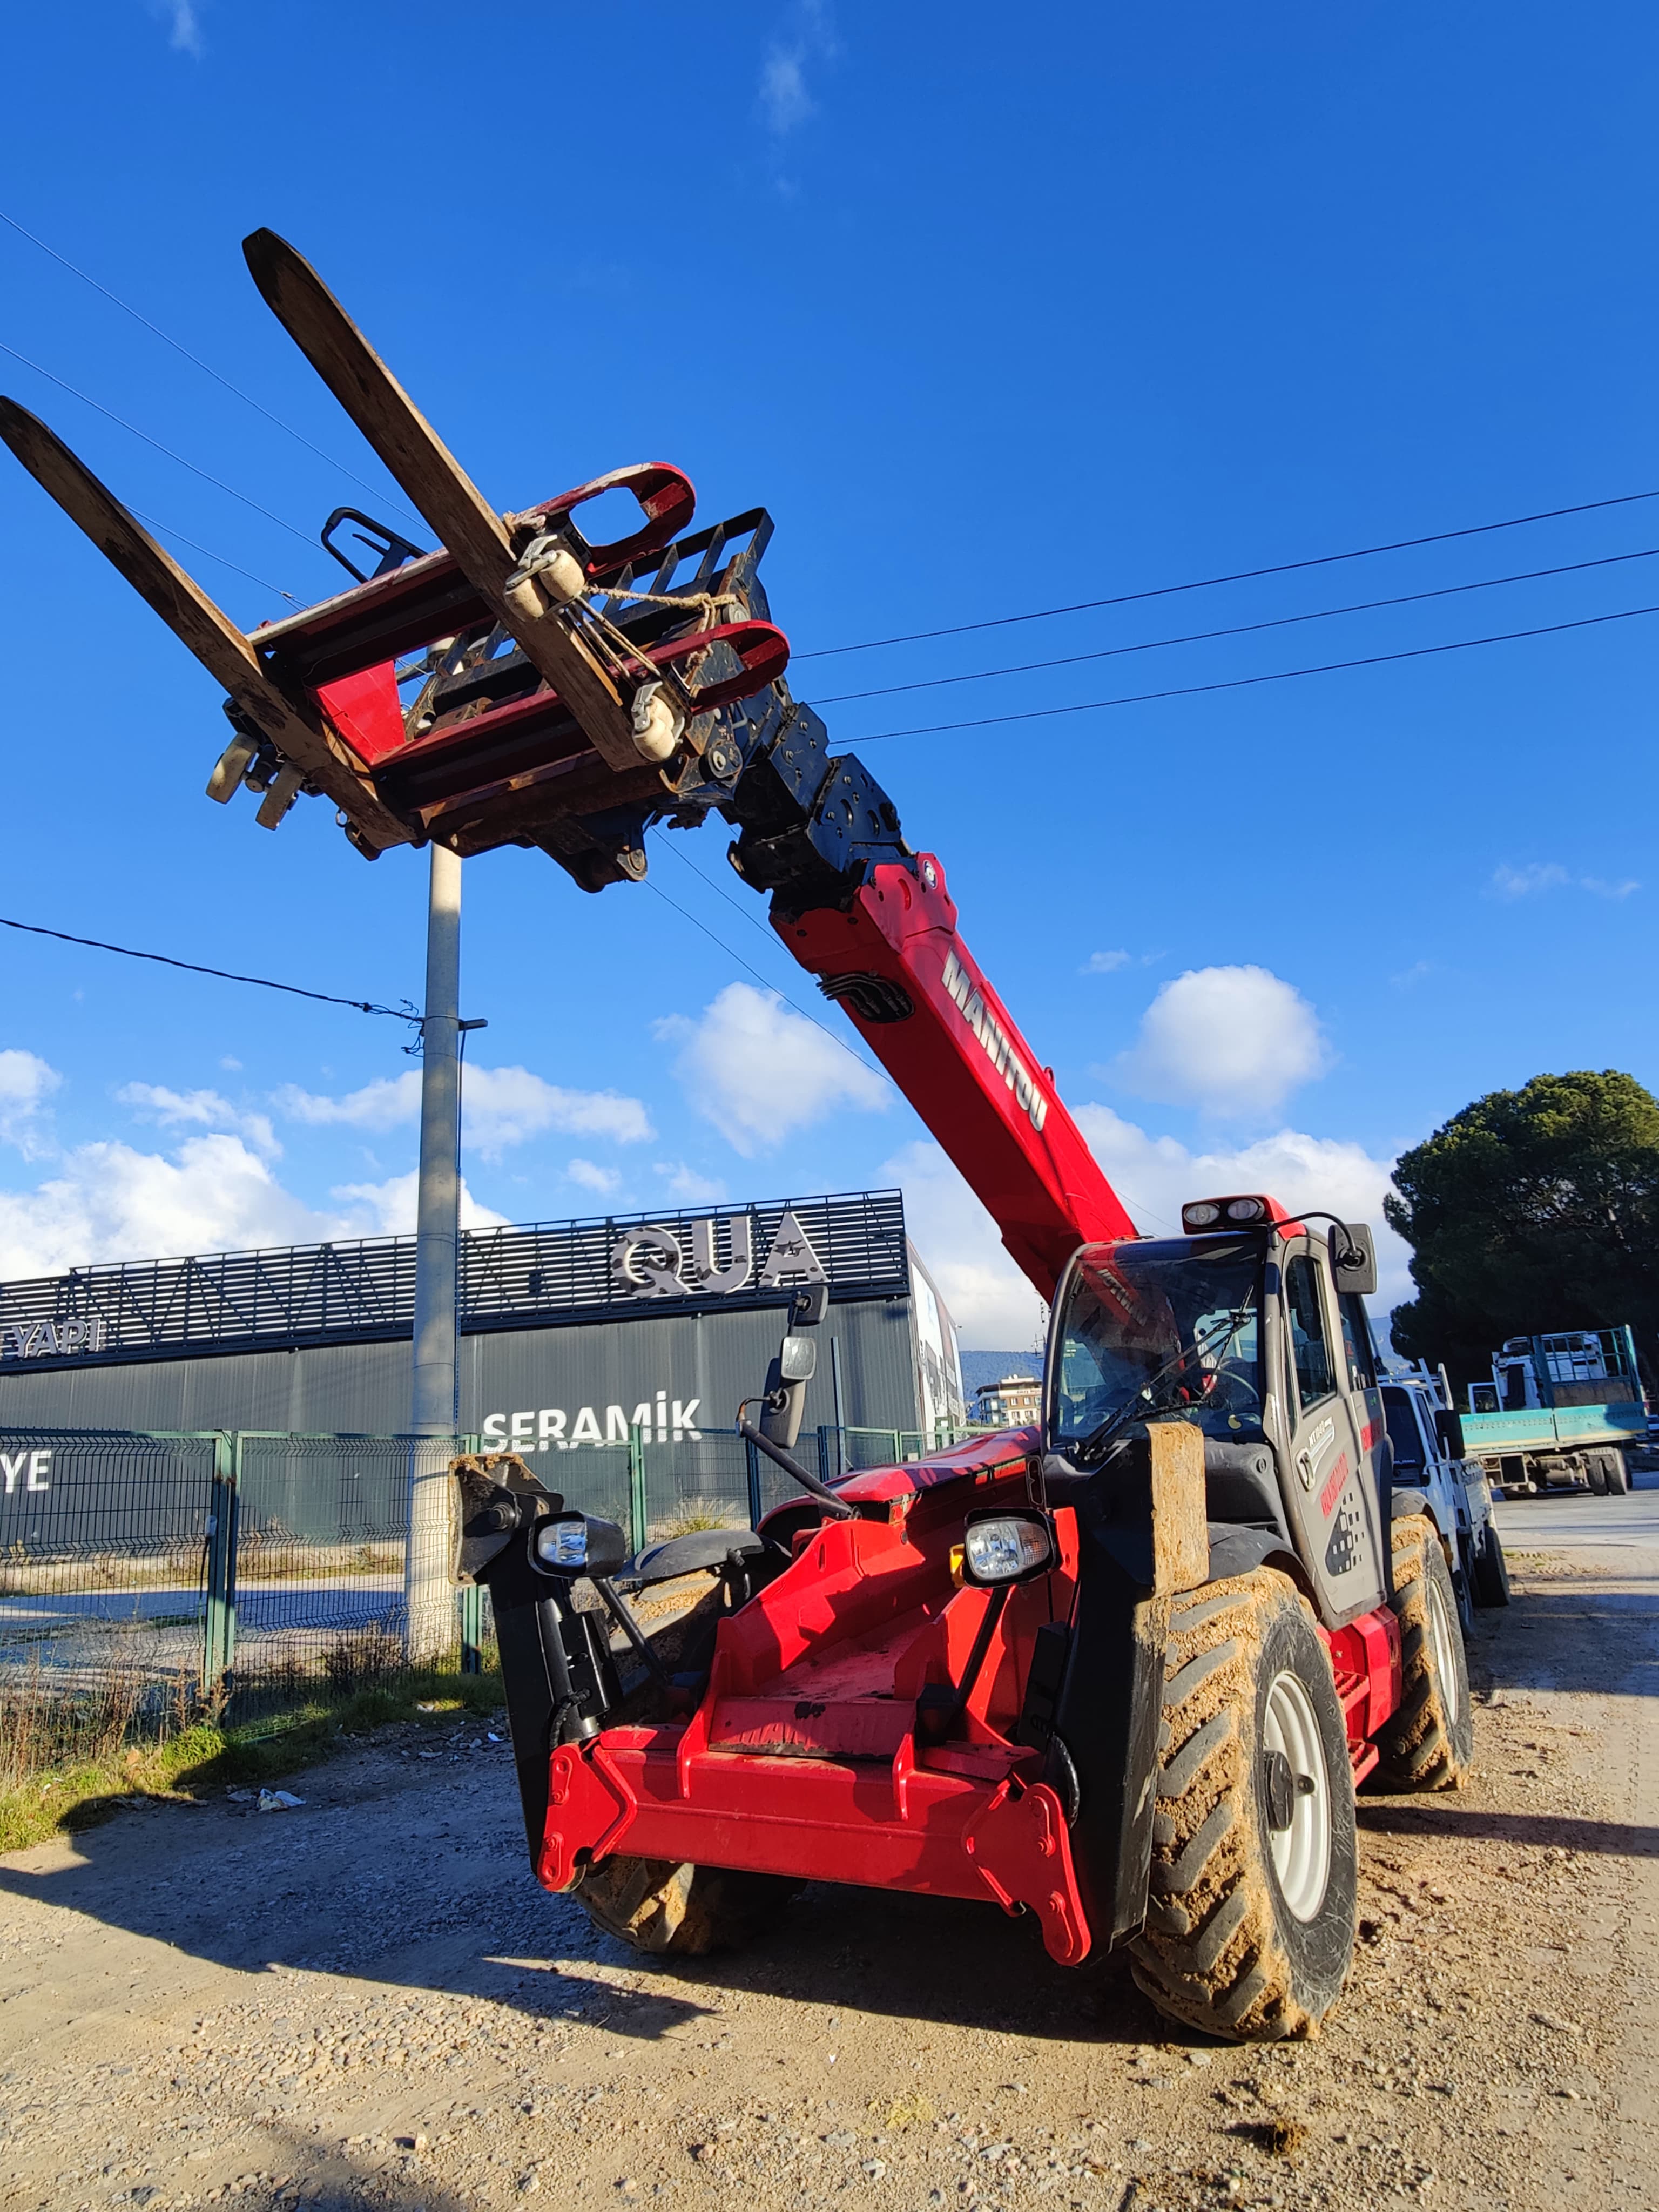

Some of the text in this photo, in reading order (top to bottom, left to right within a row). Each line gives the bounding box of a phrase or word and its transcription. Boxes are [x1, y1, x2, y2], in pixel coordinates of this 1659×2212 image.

[941, 947, 1048, 1132] MANITOU
[611, 1212, 830, 1297] QUA
[11, 1319, 100, 1358] YAPI
[483, 1390, 702, 1454] SERAMİK
[0, 1450, 52, 1493] YE
